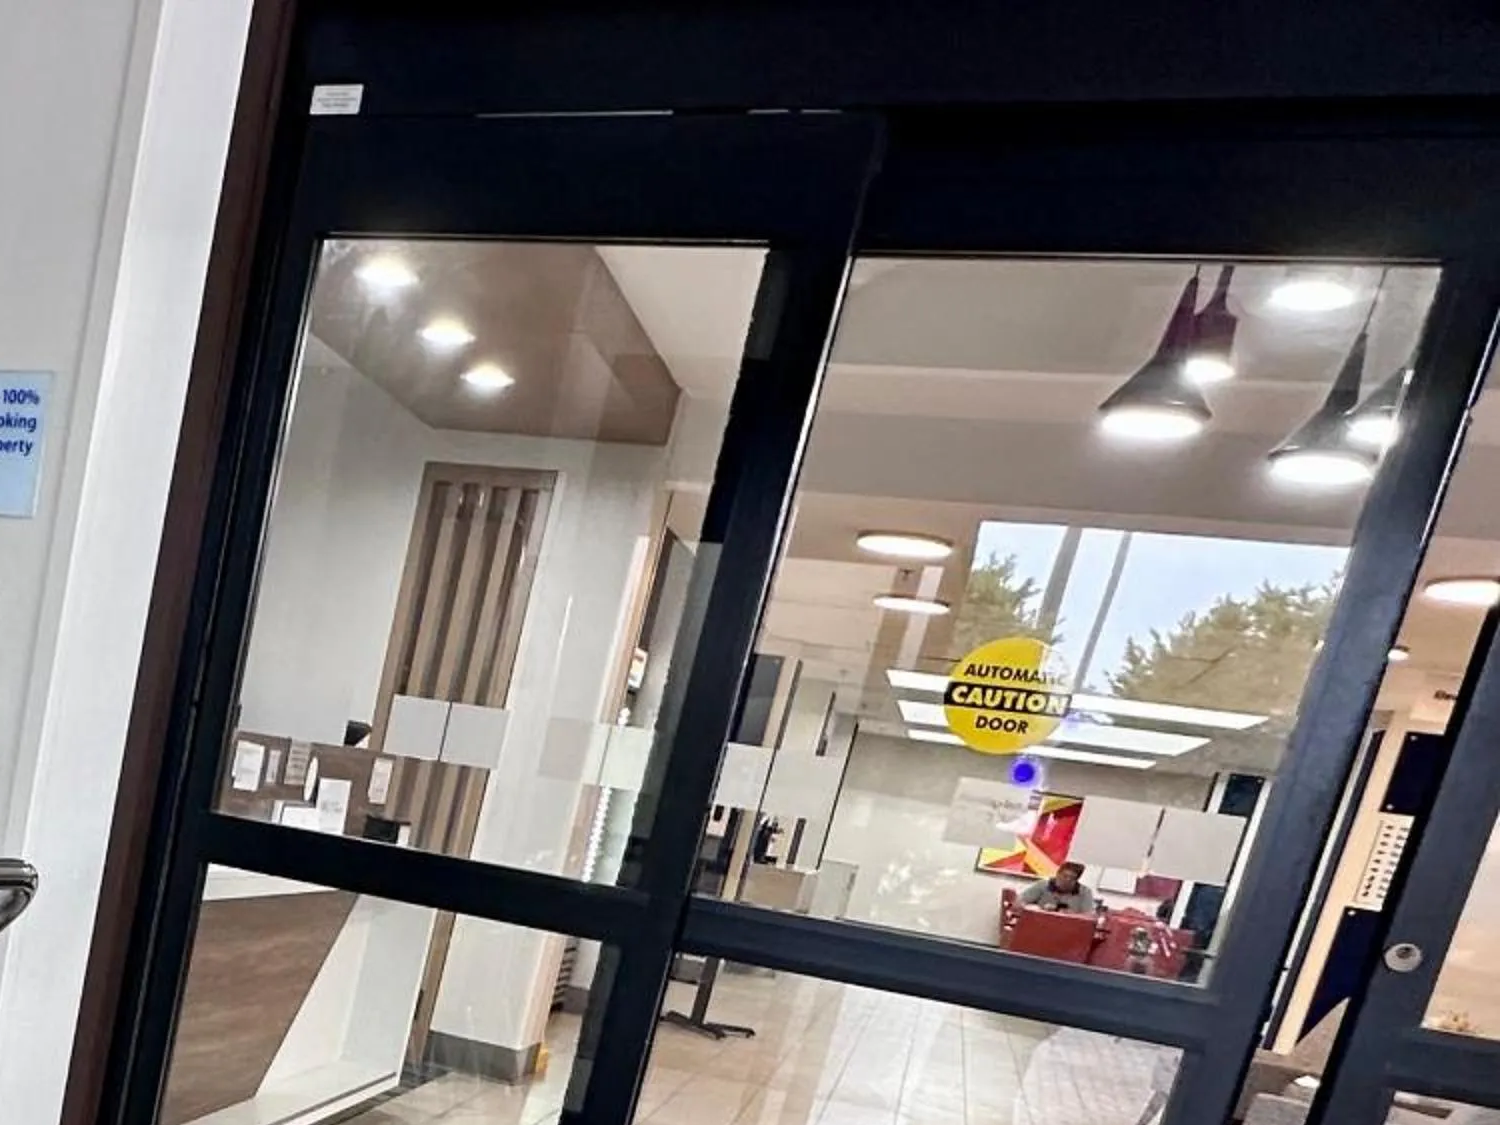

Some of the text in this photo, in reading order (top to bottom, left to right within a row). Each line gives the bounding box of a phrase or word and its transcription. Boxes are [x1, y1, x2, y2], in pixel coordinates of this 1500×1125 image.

[2, 388, 40, 405] 100%
[952, 685, 1069, 715] CAUTION
[975, 715, 1029, 735] DOOR
